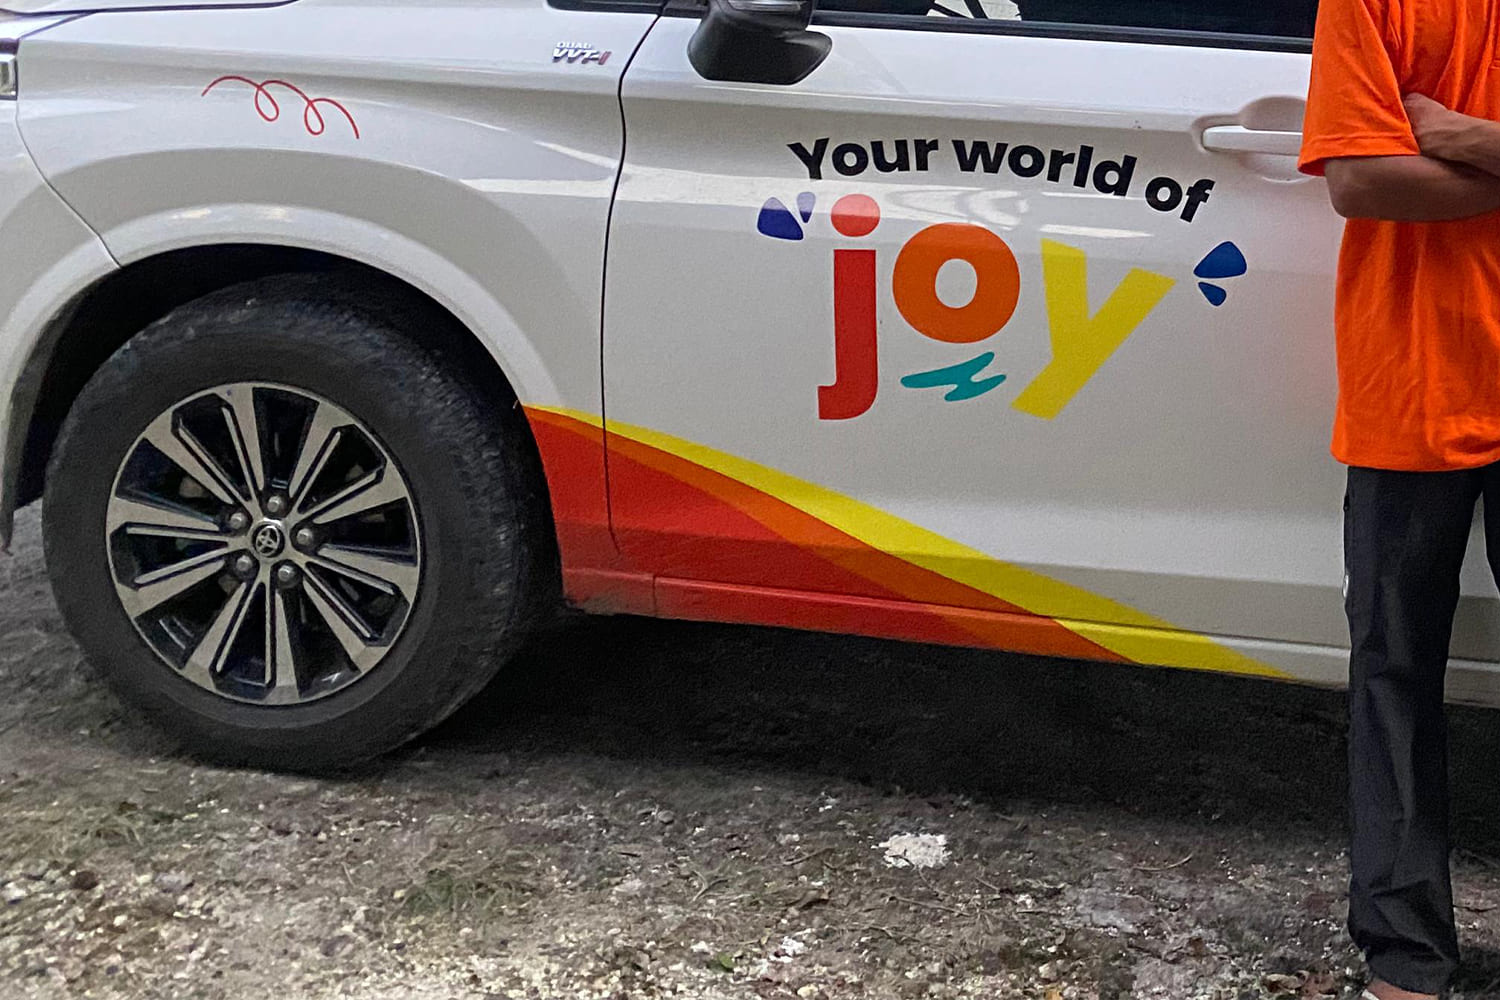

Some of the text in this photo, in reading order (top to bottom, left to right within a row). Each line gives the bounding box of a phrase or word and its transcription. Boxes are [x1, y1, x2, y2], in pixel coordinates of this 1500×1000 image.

[788, 137, 1216, 223] Your world of
[817, 193, 1176, 420] joy
